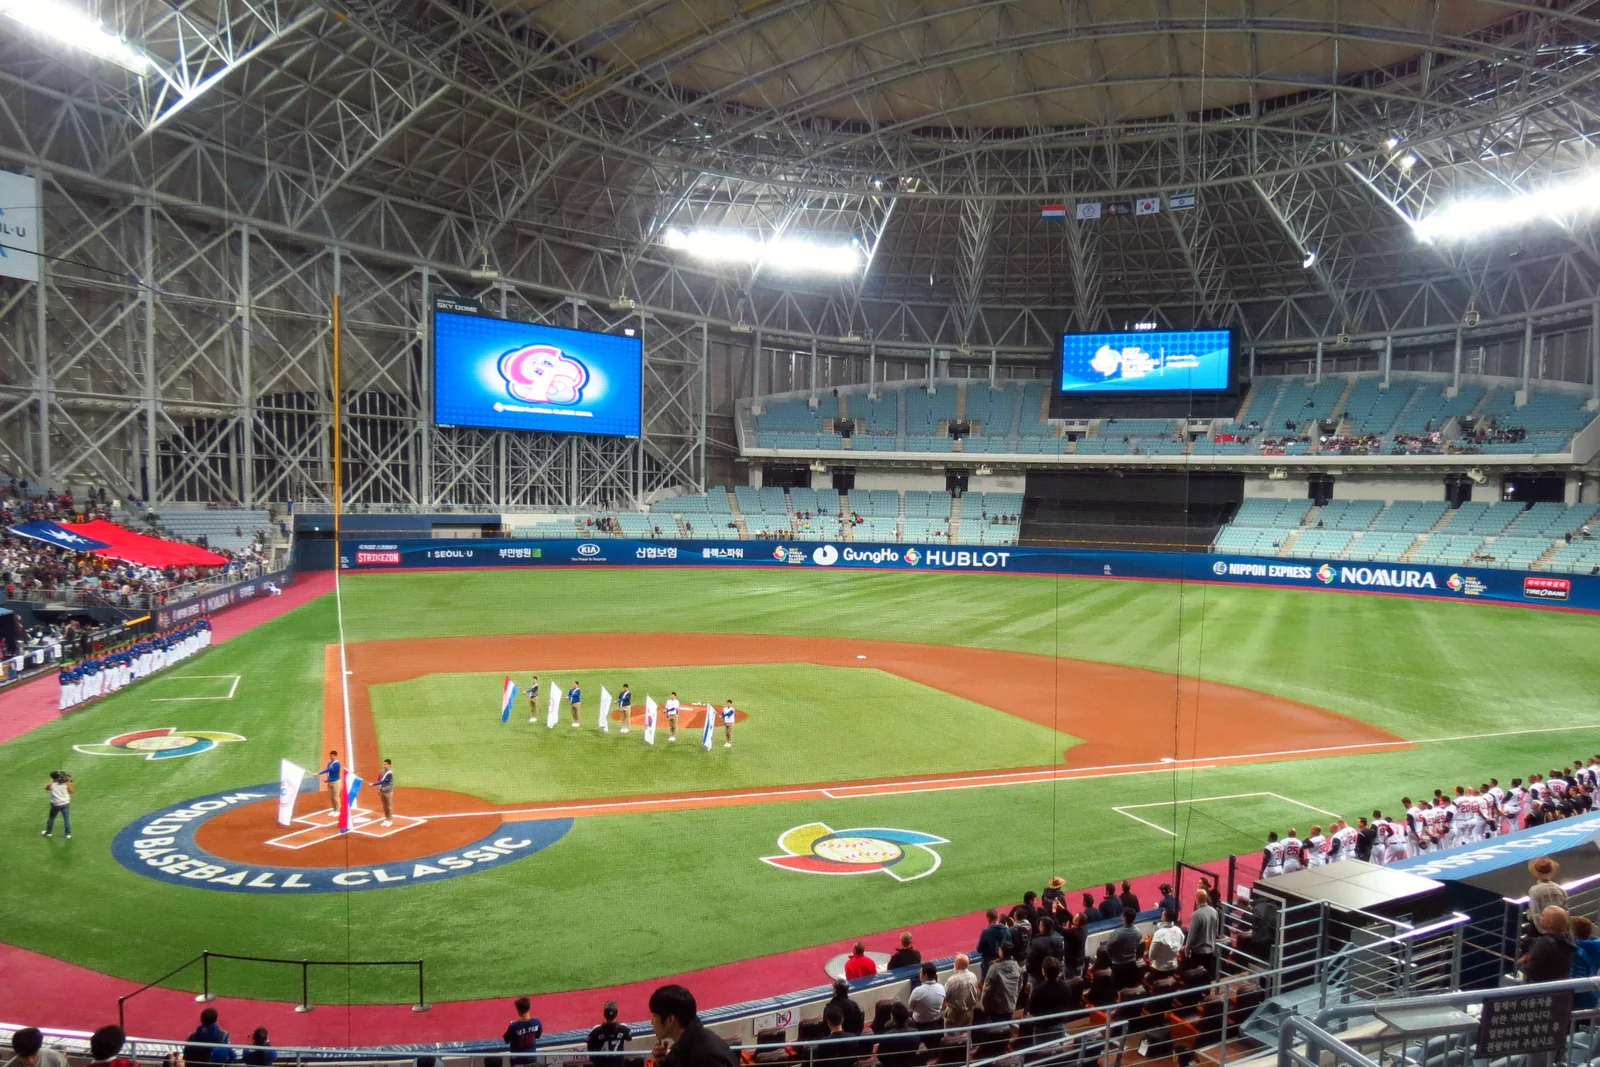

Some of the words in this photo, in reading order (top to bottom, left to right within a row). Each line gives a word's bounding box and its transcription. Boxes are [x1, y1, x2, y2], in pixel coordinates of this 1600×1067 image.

[455, 304, 478, 313] DOME
[358, 552, 400, 563] STRIKEZON
[498, 547, 532, 559] 부민병원
[581, 546, 597, 554] KIA
[636, 547, 678, 559] 신협보험
[843, 547, 899, 564] GungHo
[926, 551, 1010, 567] HUBLOT
[1229, 563, 1266, 577] NIPPON
[1268, 565, 1312, 579] EXPRESS
[1341, 567, 1436, 589] NOMURA
[141, 793, 267, 835] WORLD
[1461, 804, 1470, 813] 20
[1287, 846, 1298, 855] 25
[134, 836, 312, 888] BASEBALL
[332, 837, 532, 886] CLASSIC
[600, 1040, 621, 1057] 47
